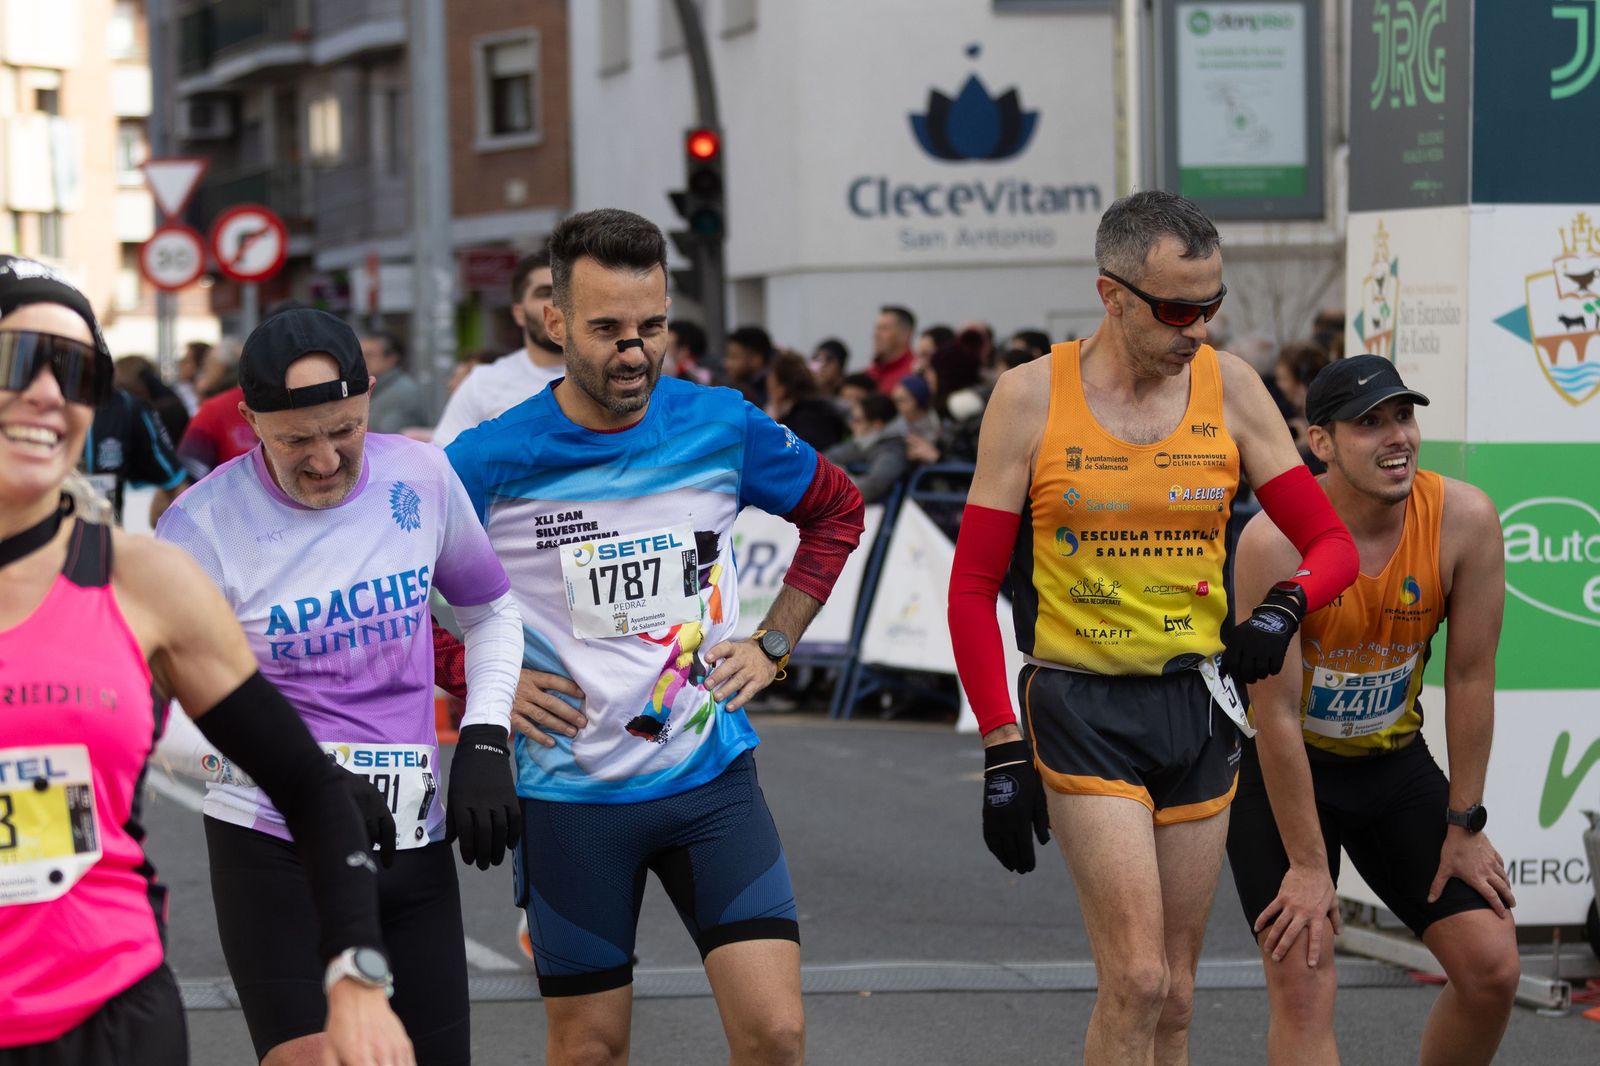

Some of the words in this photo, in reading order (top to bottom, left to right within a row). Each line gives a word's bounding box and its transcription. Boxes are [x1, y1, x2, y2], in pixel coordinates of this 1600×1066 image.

[848, 176, 1102, 218] CleceVitam
[899, 228, 945, 249] San
[956, 227, 1056, 248] Antonio
[1085, 455, 1129, 463] Ayuntamiento
[1094, 463, 1129, 471] Salamanca
[1182, 487, 1194, 501] A.
[1194, 487, 1226, 501] ELICES
[534, 515, 554, 527] XLI
[556, 510, 583, 523] SAN
[535, 521, 599, 538] SILVESTRE
[1080, 530, 1149, 541] ESCUELA
[597, 533, 683, 560] SETEL
[1096, 547, 1204, 557] SALMANTINA
[589, 557, 661, 605] 1787
[264, 565, 430, 636] APACHES
[613, 599, 647, 612] PEDRAZ
[1328, 595, 1344, 608] KT
[630, 612, 665, 624] Ayuntamiento
[639, 620, 666, 631] Salamanca
[1075, 628, 1133, 638] ALTAFIT
[1345, 665, 1410, 687] SETEL
[1327, 686, 1394, 717] 4410
[474, 744, 504, 755] KIPRUN
[353, 751, 422, 768] SETEL
